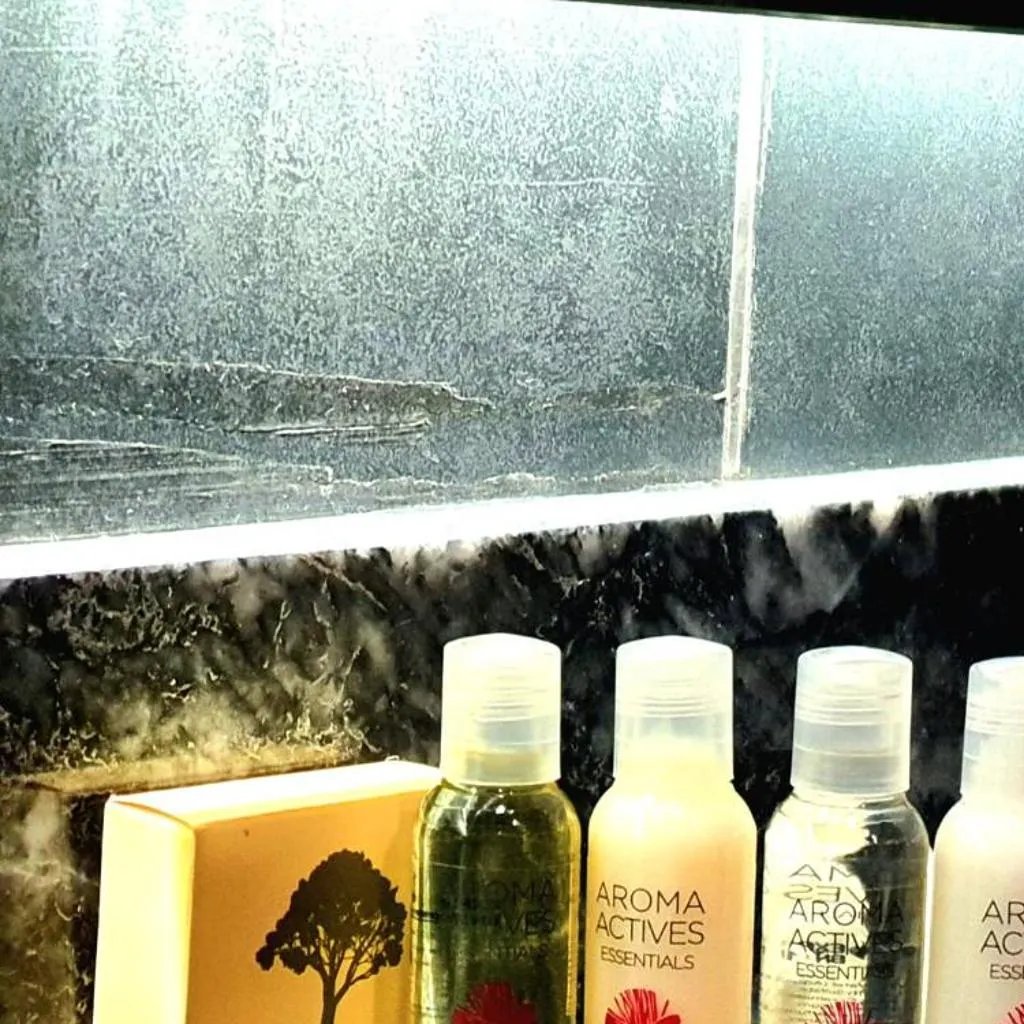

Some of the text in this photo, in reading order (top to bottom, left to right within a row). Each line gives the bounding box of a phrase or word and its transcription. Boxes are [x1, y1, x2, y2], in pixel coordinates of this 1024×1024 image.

[596, 881, 706, 914] AROMA
[789, 898, 904, 926] AROMA
[596, 912, 705, 945] ACTIVES
[788, 928, 903, 955] ACTIVES
[600, 946, 695, 970] ESSENTIALS
[796, 962, 895, 981] ESSENTI
